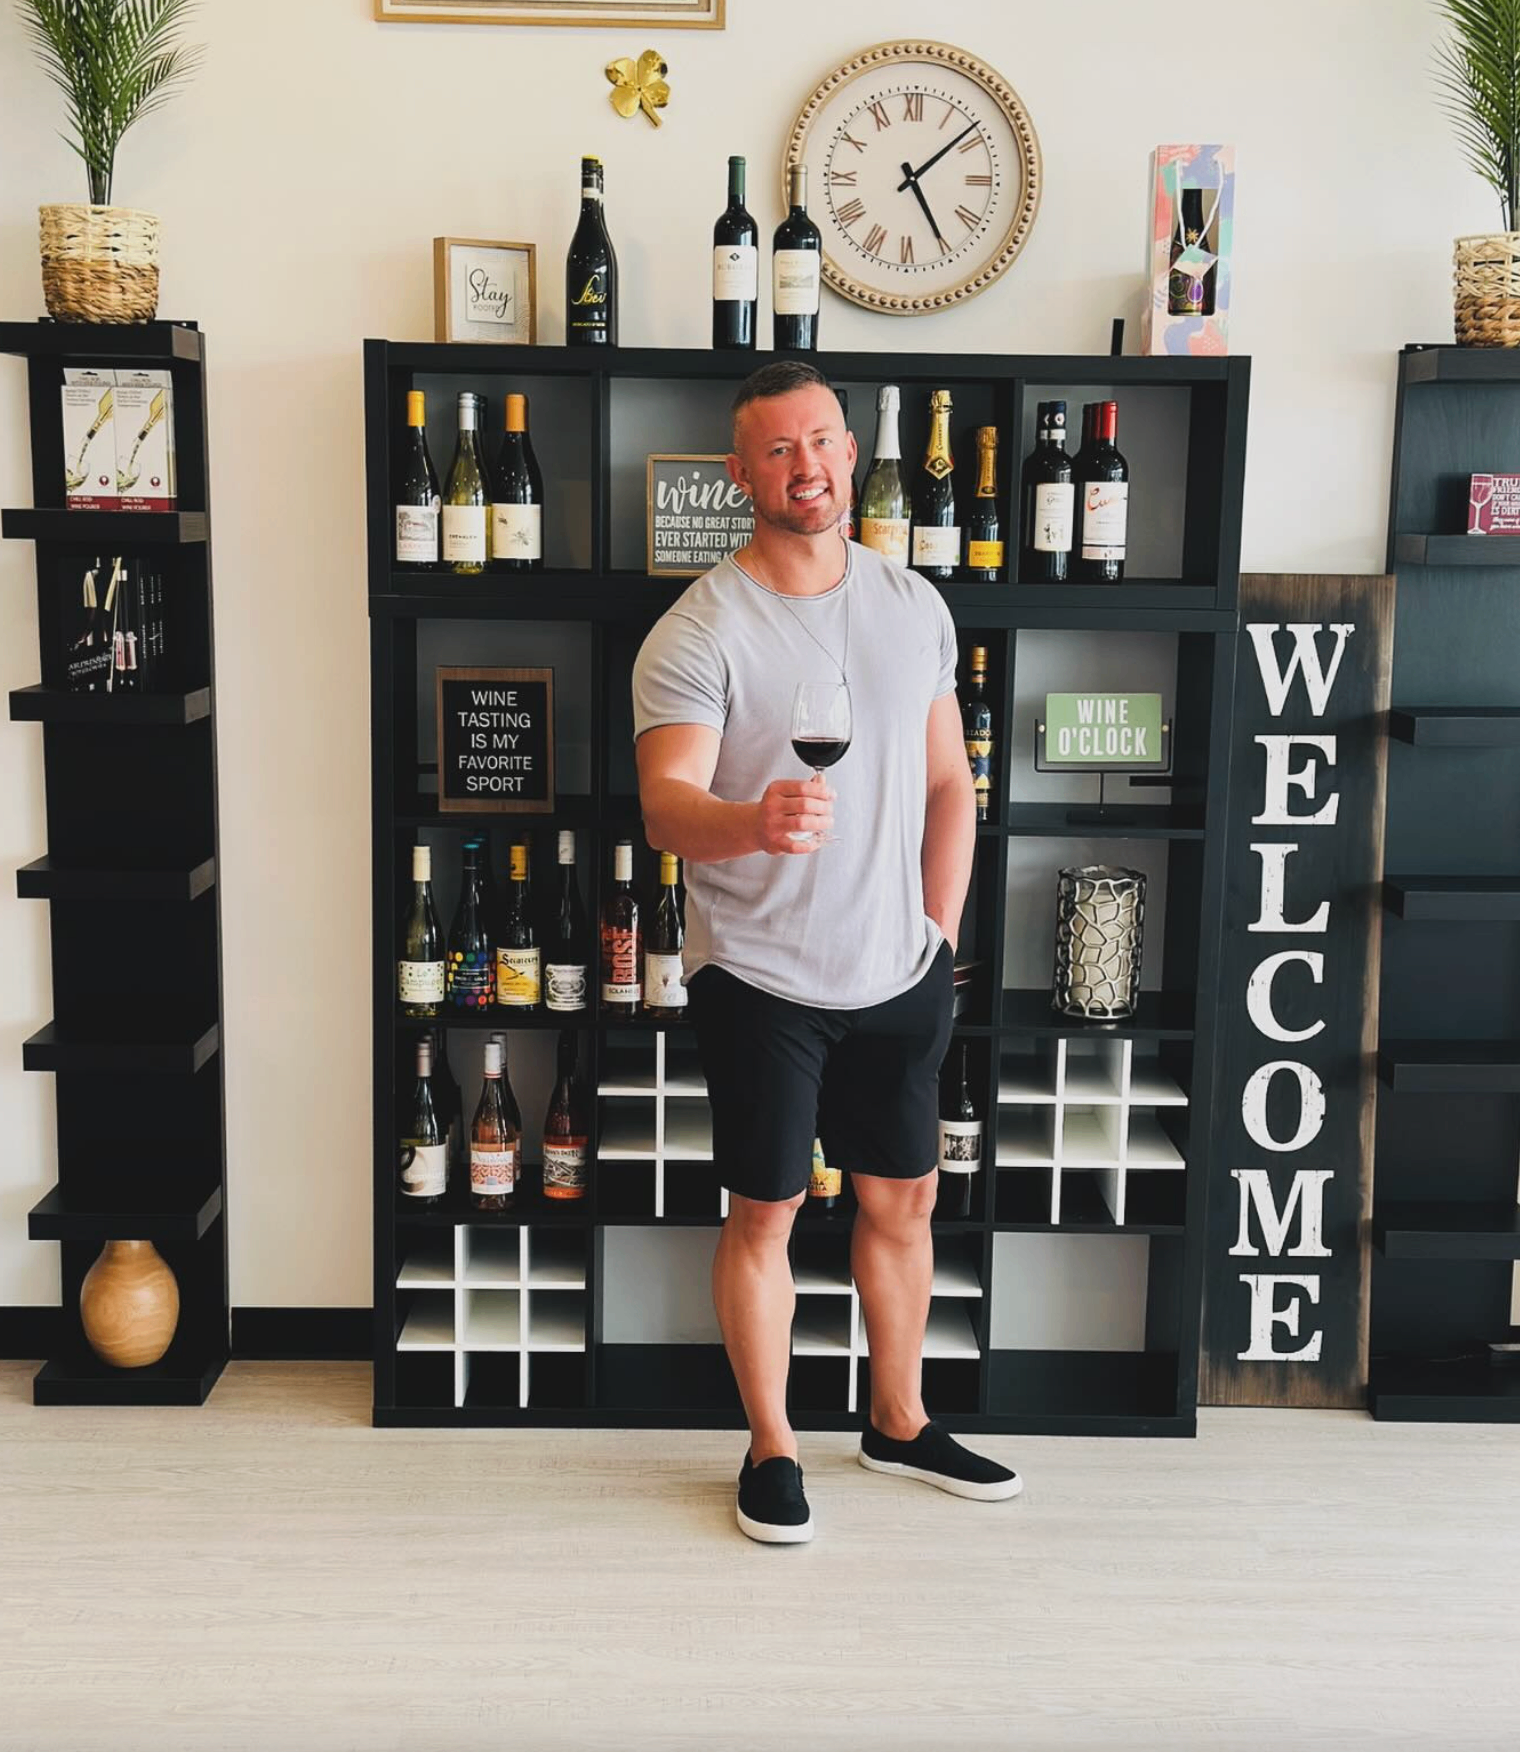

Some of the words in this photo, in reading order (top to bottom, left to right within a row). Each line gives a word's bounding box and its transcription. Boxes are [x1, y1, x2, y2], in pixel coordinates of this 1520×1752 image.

[903, 93, 923, 121] XII
[469, 268, 513, 318] Stay
[655, 516, 690, 528] BECAUSE
[692, 517, 704, 529] NO
[705, 517, 729, 530] GREAT
[655, 531, 681, 547] EVER
[683, 532, 728, 548] STARTED
[655, 550, 692, 563] SOMEONE
[693, 551, 722, 564] EATING
[471, 690, 518, 706] WINE
[1077, 699, 1128, 724] WINE
[457, 712, 531, 728] TASTING
[471, 733, 488, 749] IS
[493, 734, 519, 749] MY
[1058, 726, 1147, 756] O'CLOCK
[459, 755, 533, 770] FAVORITE
[466, 776, 524, 792] SPORT
[1228, 622, 1356, 1363] WELCOME
